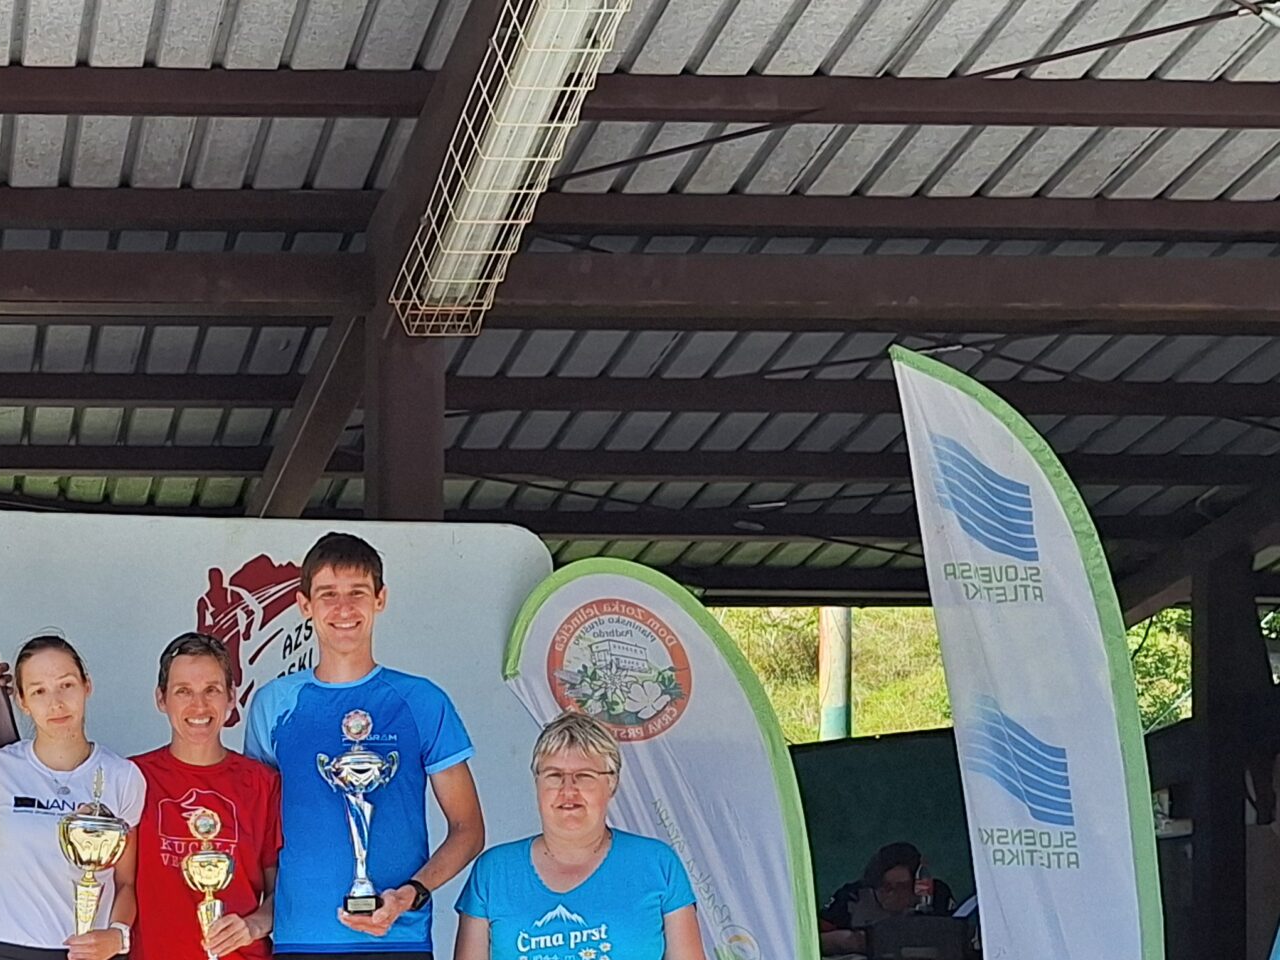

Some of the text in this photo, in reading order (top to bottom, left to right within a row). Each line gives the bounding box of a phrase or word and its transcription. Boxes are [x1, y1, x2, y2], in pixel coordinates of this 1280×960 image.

[282, 617, 313, 659] AZS
[36, 798, 85, 812] NAN
[517, 924, 608, 952] Črna prst
